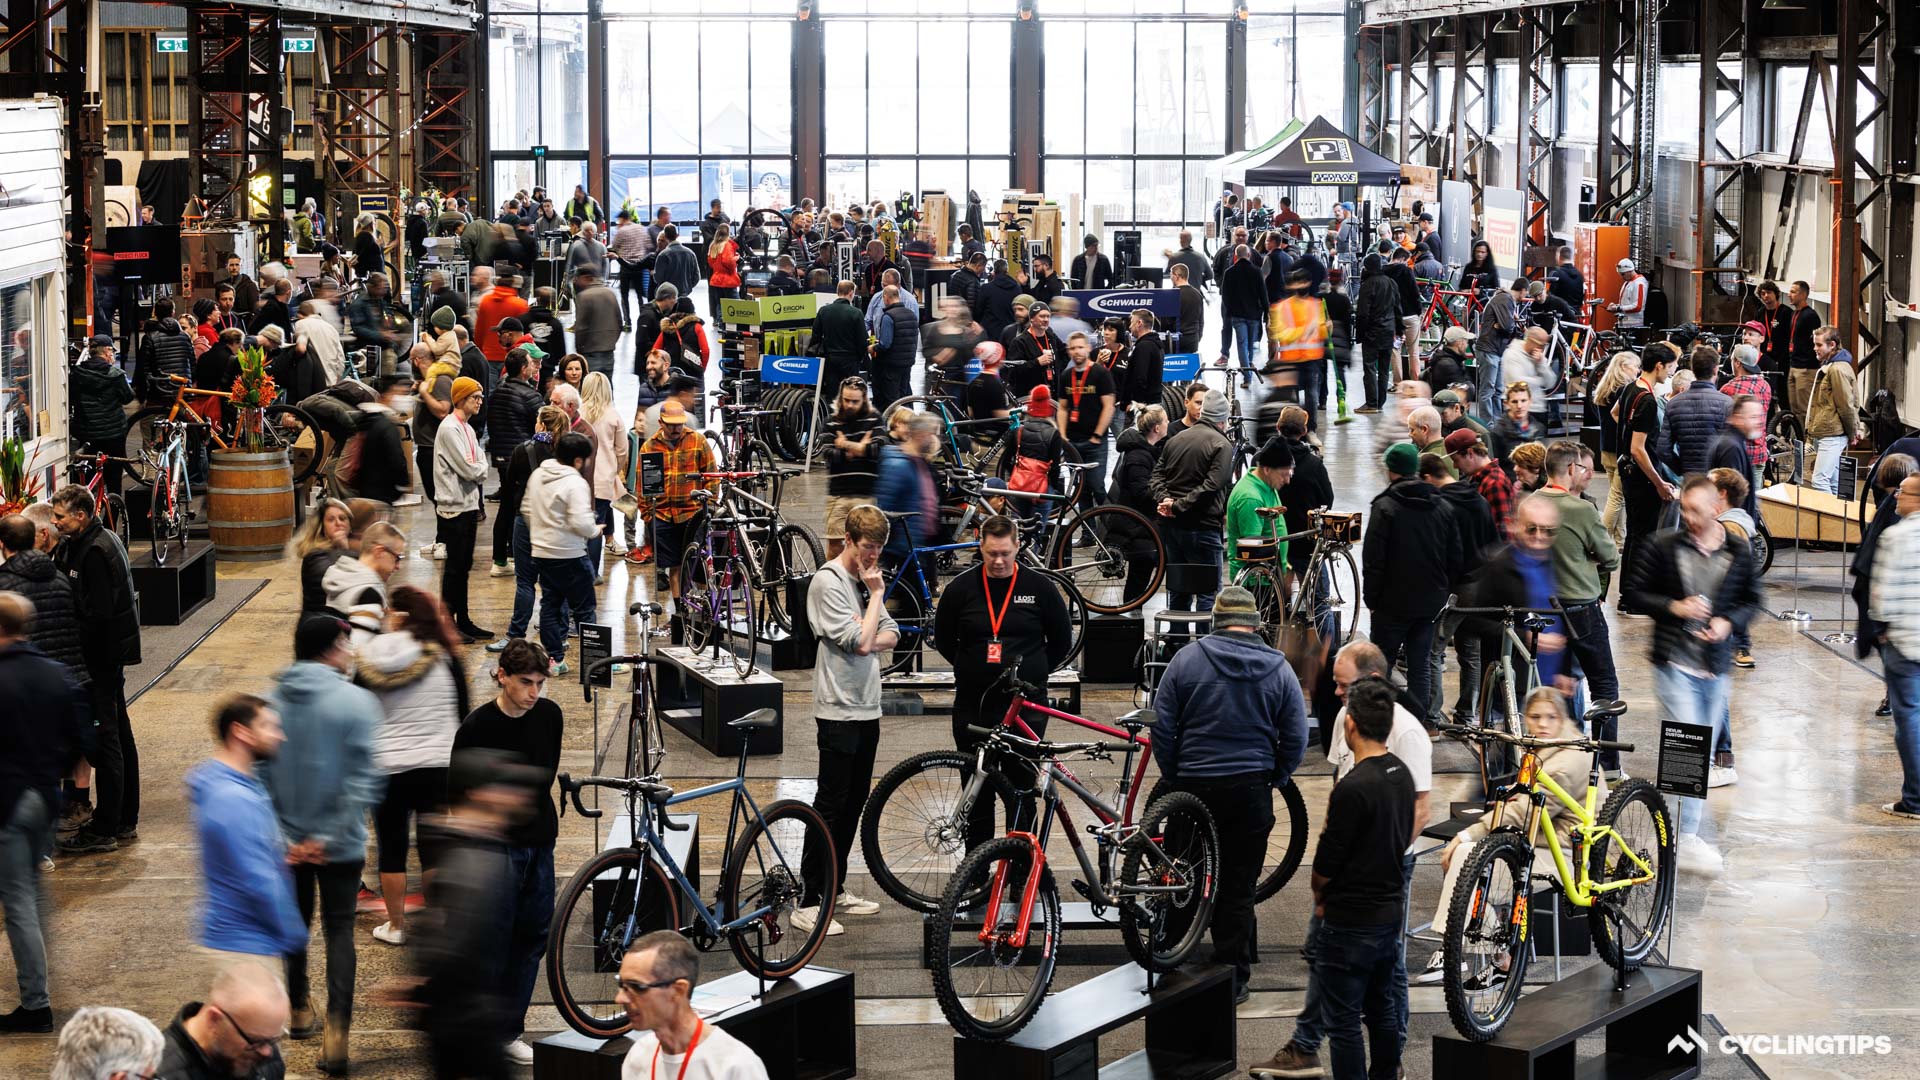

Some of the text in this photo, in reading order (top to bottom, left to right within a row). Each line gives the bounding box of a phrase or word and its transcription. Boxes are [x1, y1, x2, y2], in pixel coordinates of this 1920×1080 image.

[1012, 236, 1020, 264] MAVIC
[1099, 298, 1153, 307] SCHWALBE
[783, 304, 805, 312] ERGON
[779, 361, 809, 369] SCHWALBE
[921, 758, 966, 768] GOODYEAR
